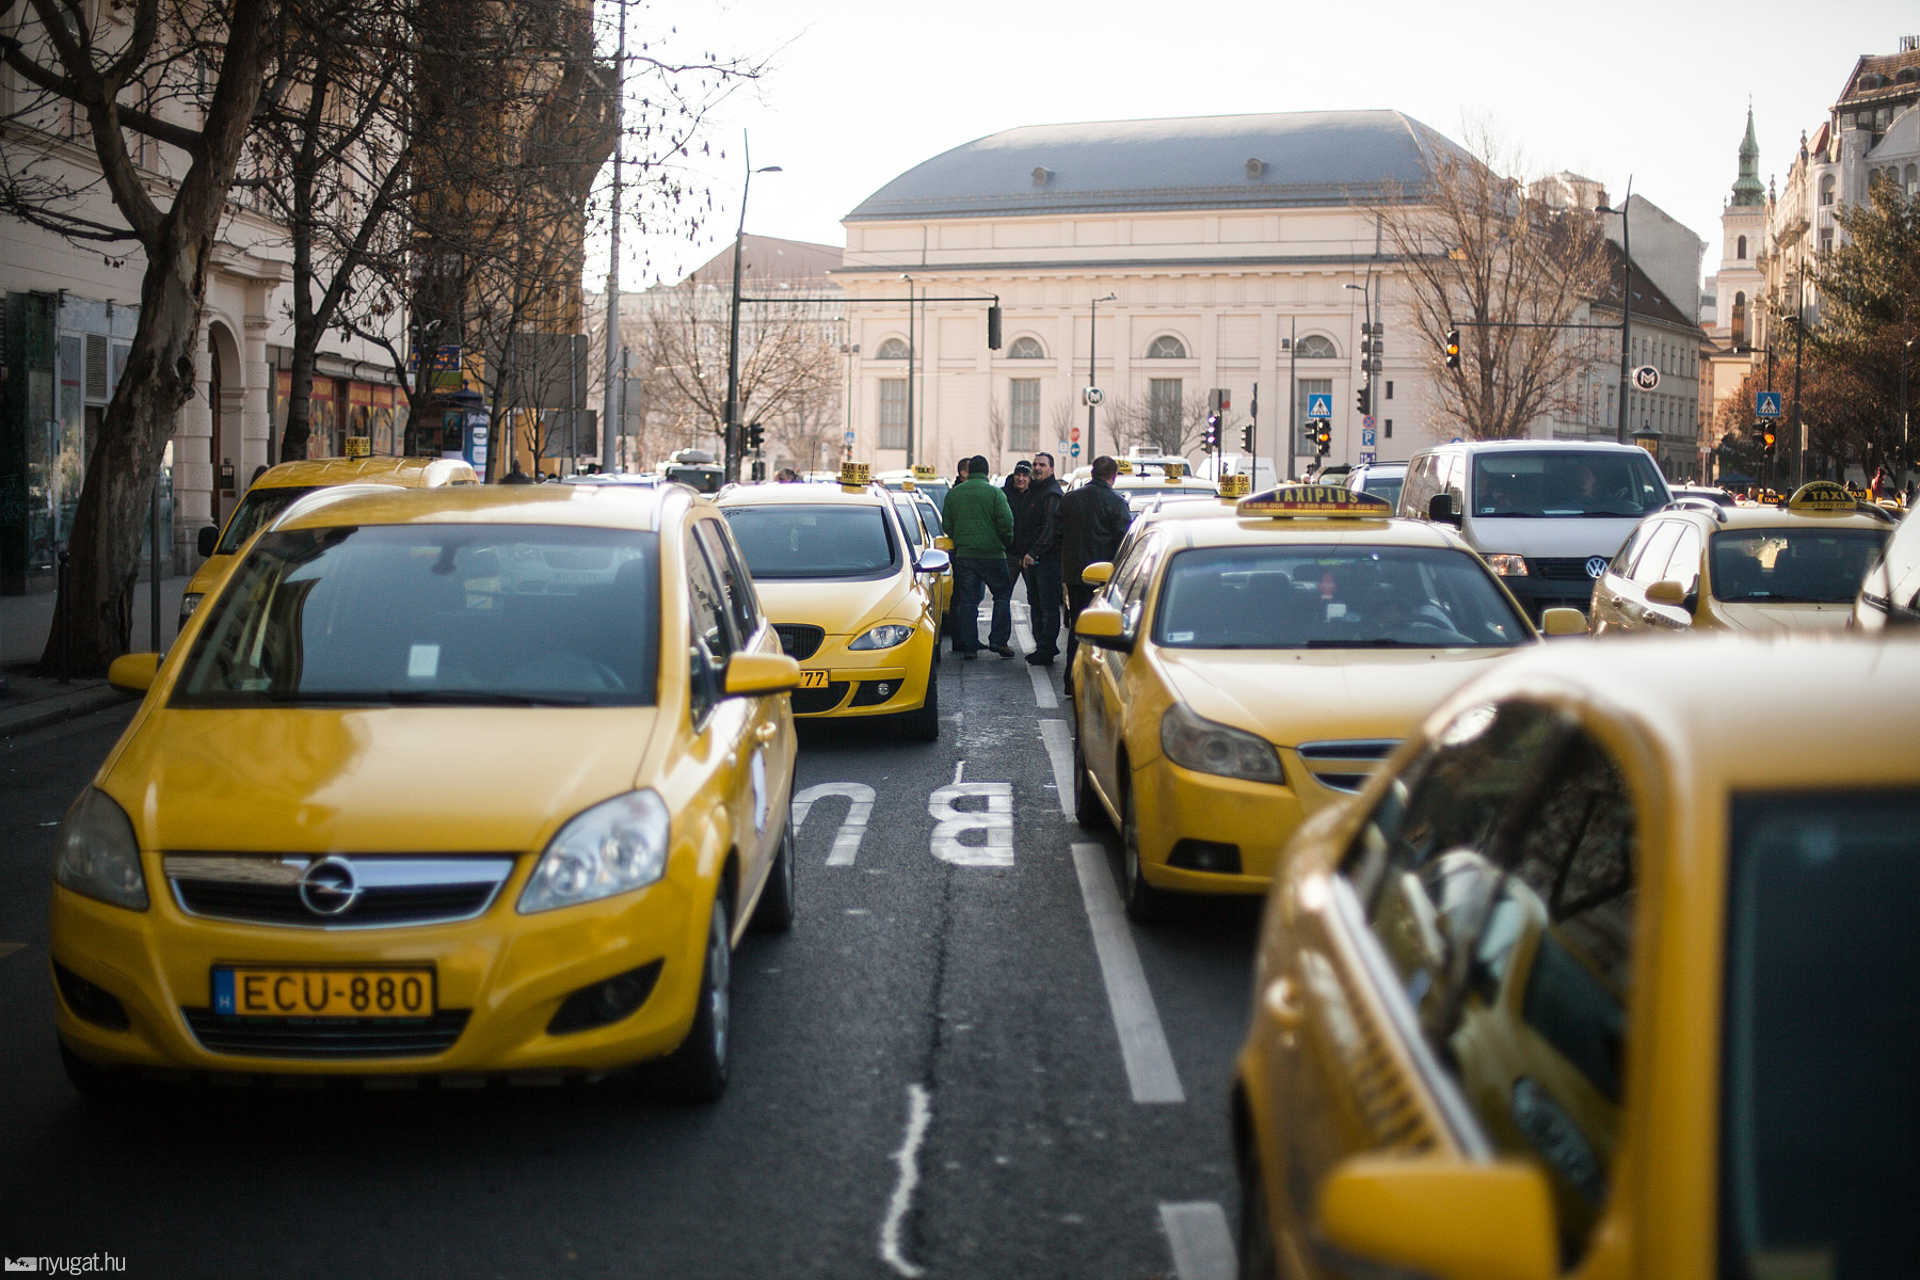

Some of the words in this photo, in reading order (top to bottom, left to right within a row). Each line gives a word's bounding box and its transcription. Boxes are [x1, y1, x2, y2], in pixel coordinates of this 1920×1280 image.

[1274, 488, 1359, 503] TAXIPLUS
[1811, 490, 1846, 501] TAXI
[801, 671, 824, 686] 77
[244, 976, 422, 1011] ECU-880
